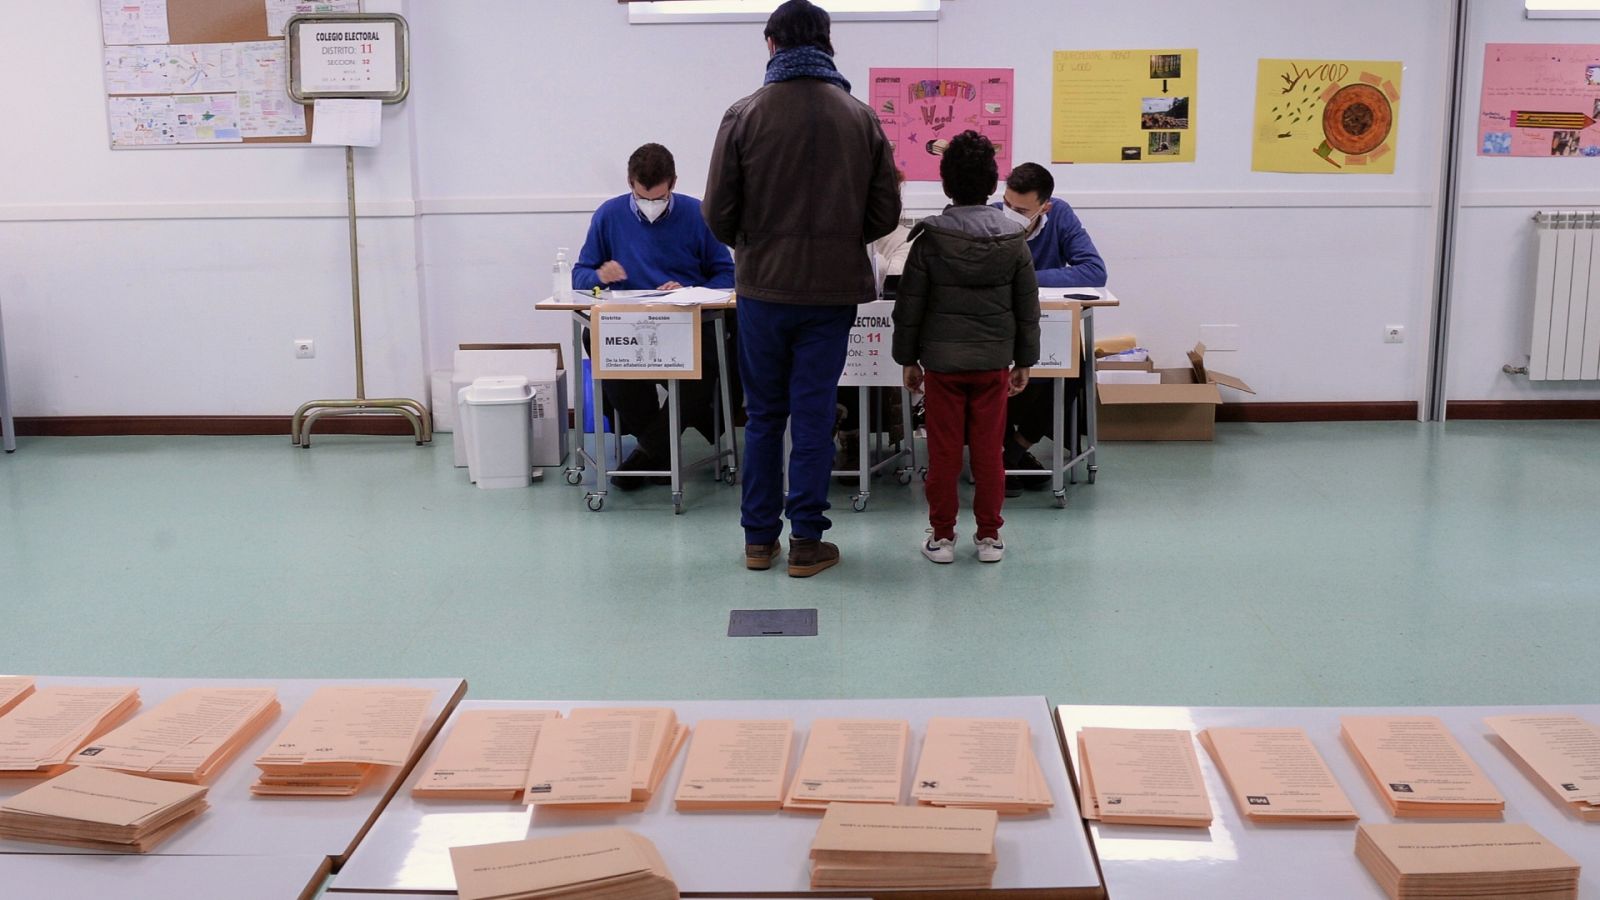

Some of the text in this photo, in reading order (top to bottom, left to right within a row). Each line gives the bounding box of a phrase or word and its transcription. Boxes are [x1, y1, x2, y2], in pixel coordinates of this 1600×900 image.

[315, 32, 380, 41] COLEGIO ELECTORAL
[321, 44, 373, 55] DISTRITO: 11
[1290, 62, 1349, 82] WOOD
[920, 105, 953, 125] Wood
[605, 336, 639, 346] MESA
[866, 333, 880, 343] 11
